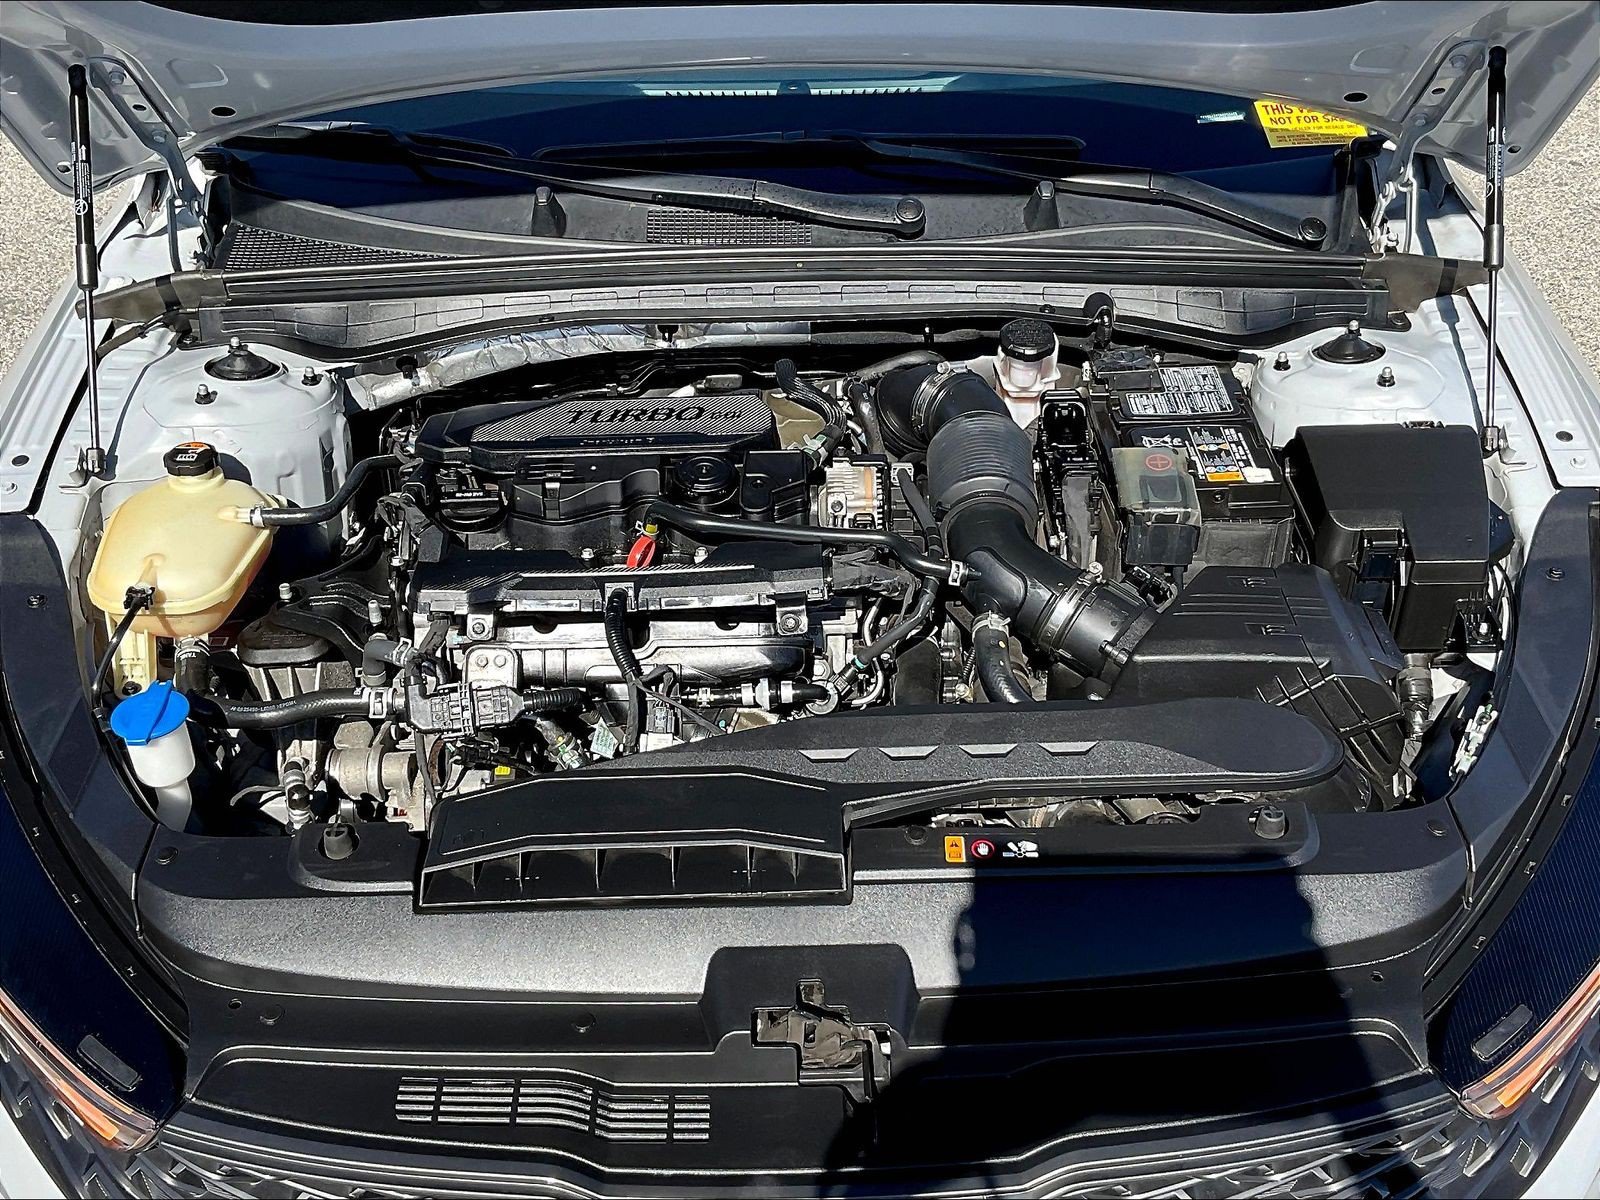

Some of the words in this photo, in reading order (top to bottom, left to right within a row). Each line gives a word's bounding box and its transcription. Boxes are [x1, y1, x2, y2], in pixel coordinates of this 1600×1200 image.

[1262, 104, 1293, 115] THIS
[1270, 116, 1293, 126] NOT
[1296, 115, 1319, 124] FOR
[568, 406, 705, 424] TURBO
